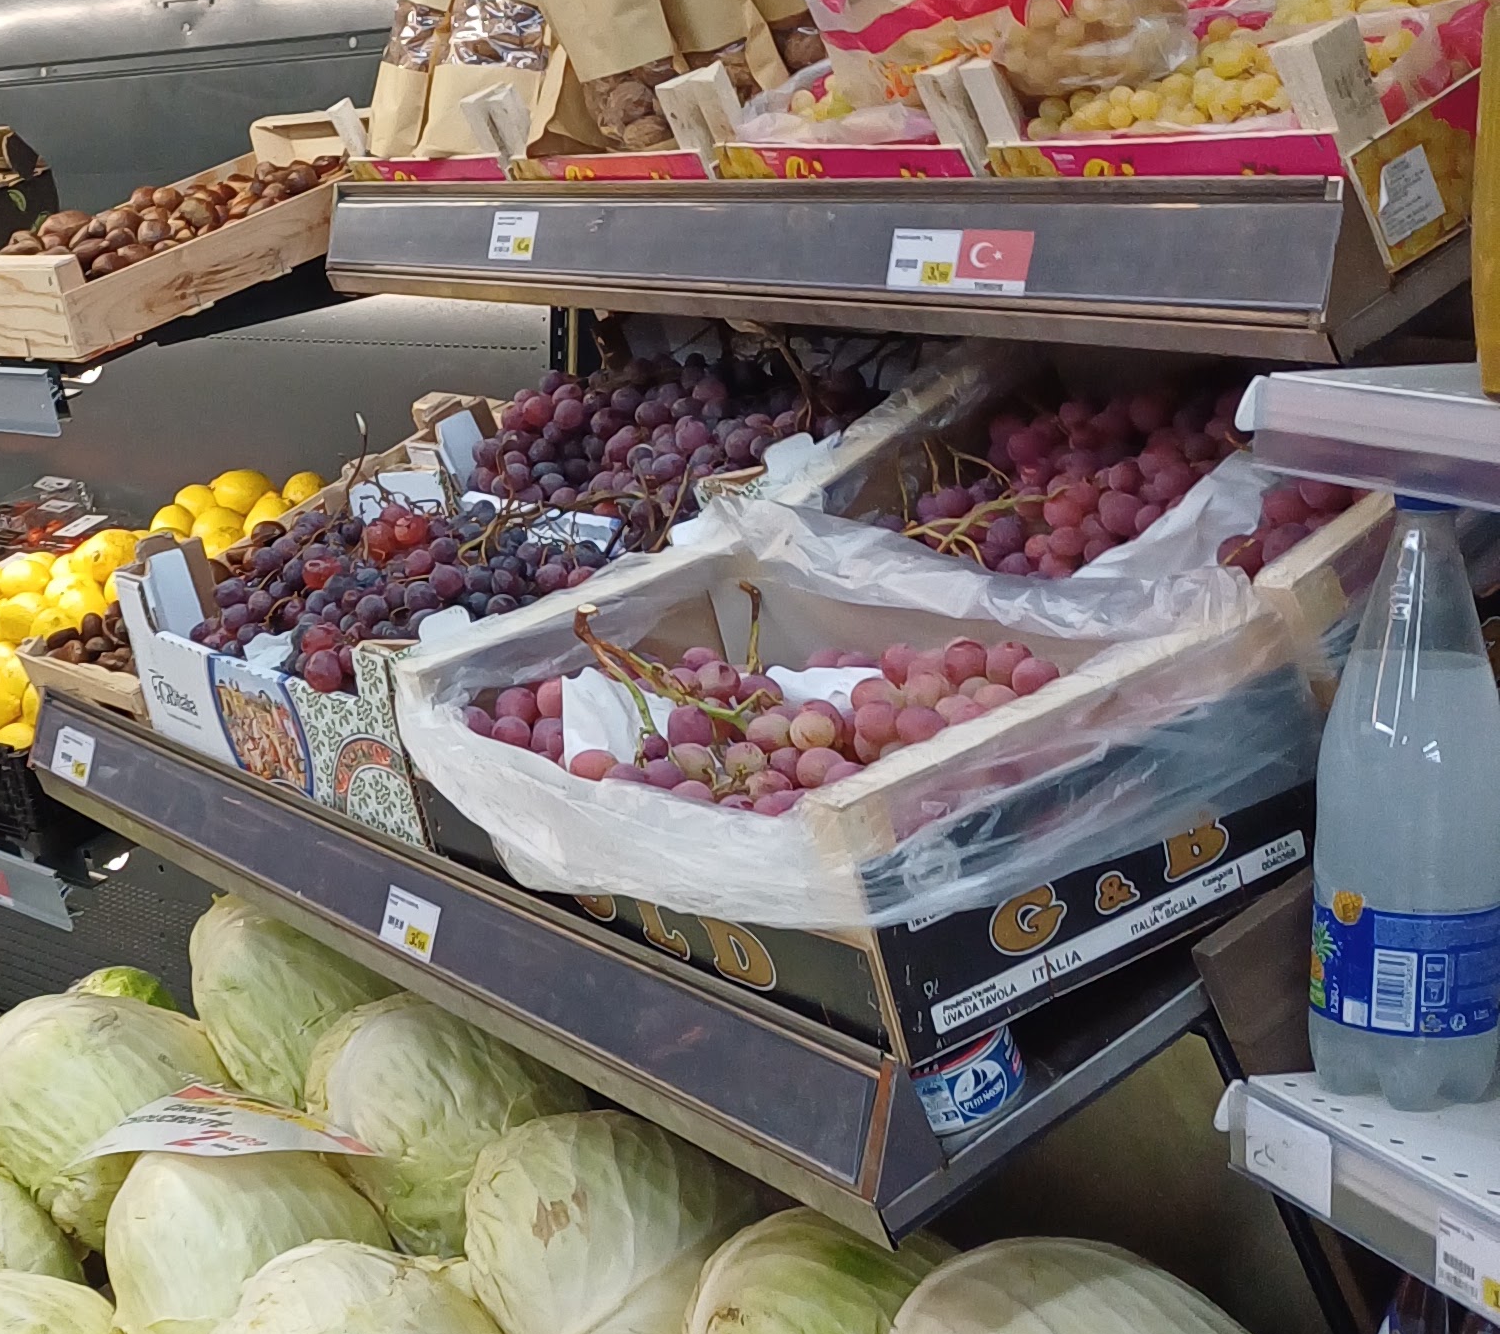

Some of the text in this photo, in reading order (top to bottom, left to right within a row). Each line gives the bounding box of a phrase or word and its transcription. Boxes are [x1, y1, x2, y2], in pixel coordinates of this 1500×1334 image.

[1032, 949, 1083, 983] ITALIA
[942, 1008, 965, 1027] UVA
[964, 1003, 979, 1019] DA
[980, 982, 1018, 1013] TAVOLA
